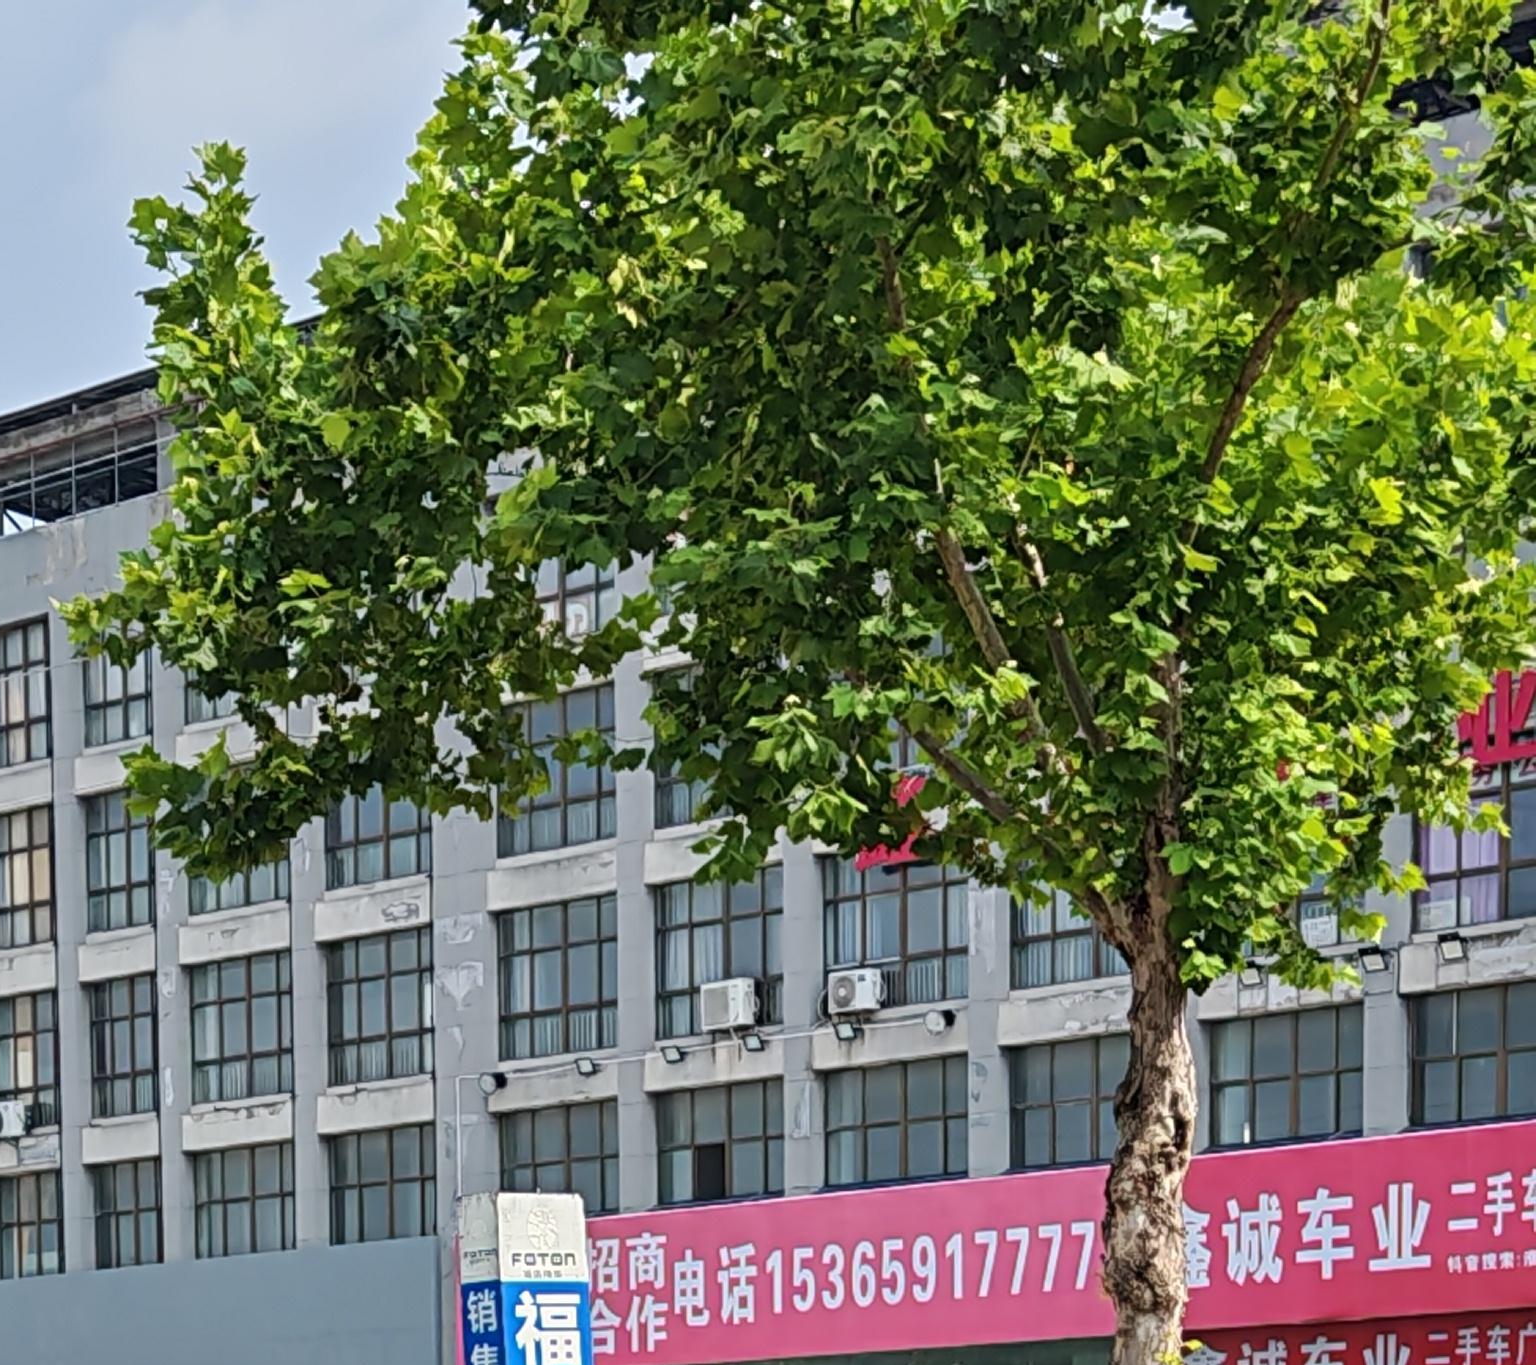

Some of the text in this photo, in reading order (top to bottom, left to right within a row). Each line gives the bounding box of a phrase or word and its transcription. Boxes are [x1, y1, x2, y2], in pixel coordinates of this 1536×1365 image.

[511, 1252, 577, 1267] FOTON
[588, 1232, 667, 1293] 招商
[591, 1294, 669, 1354] 合作
